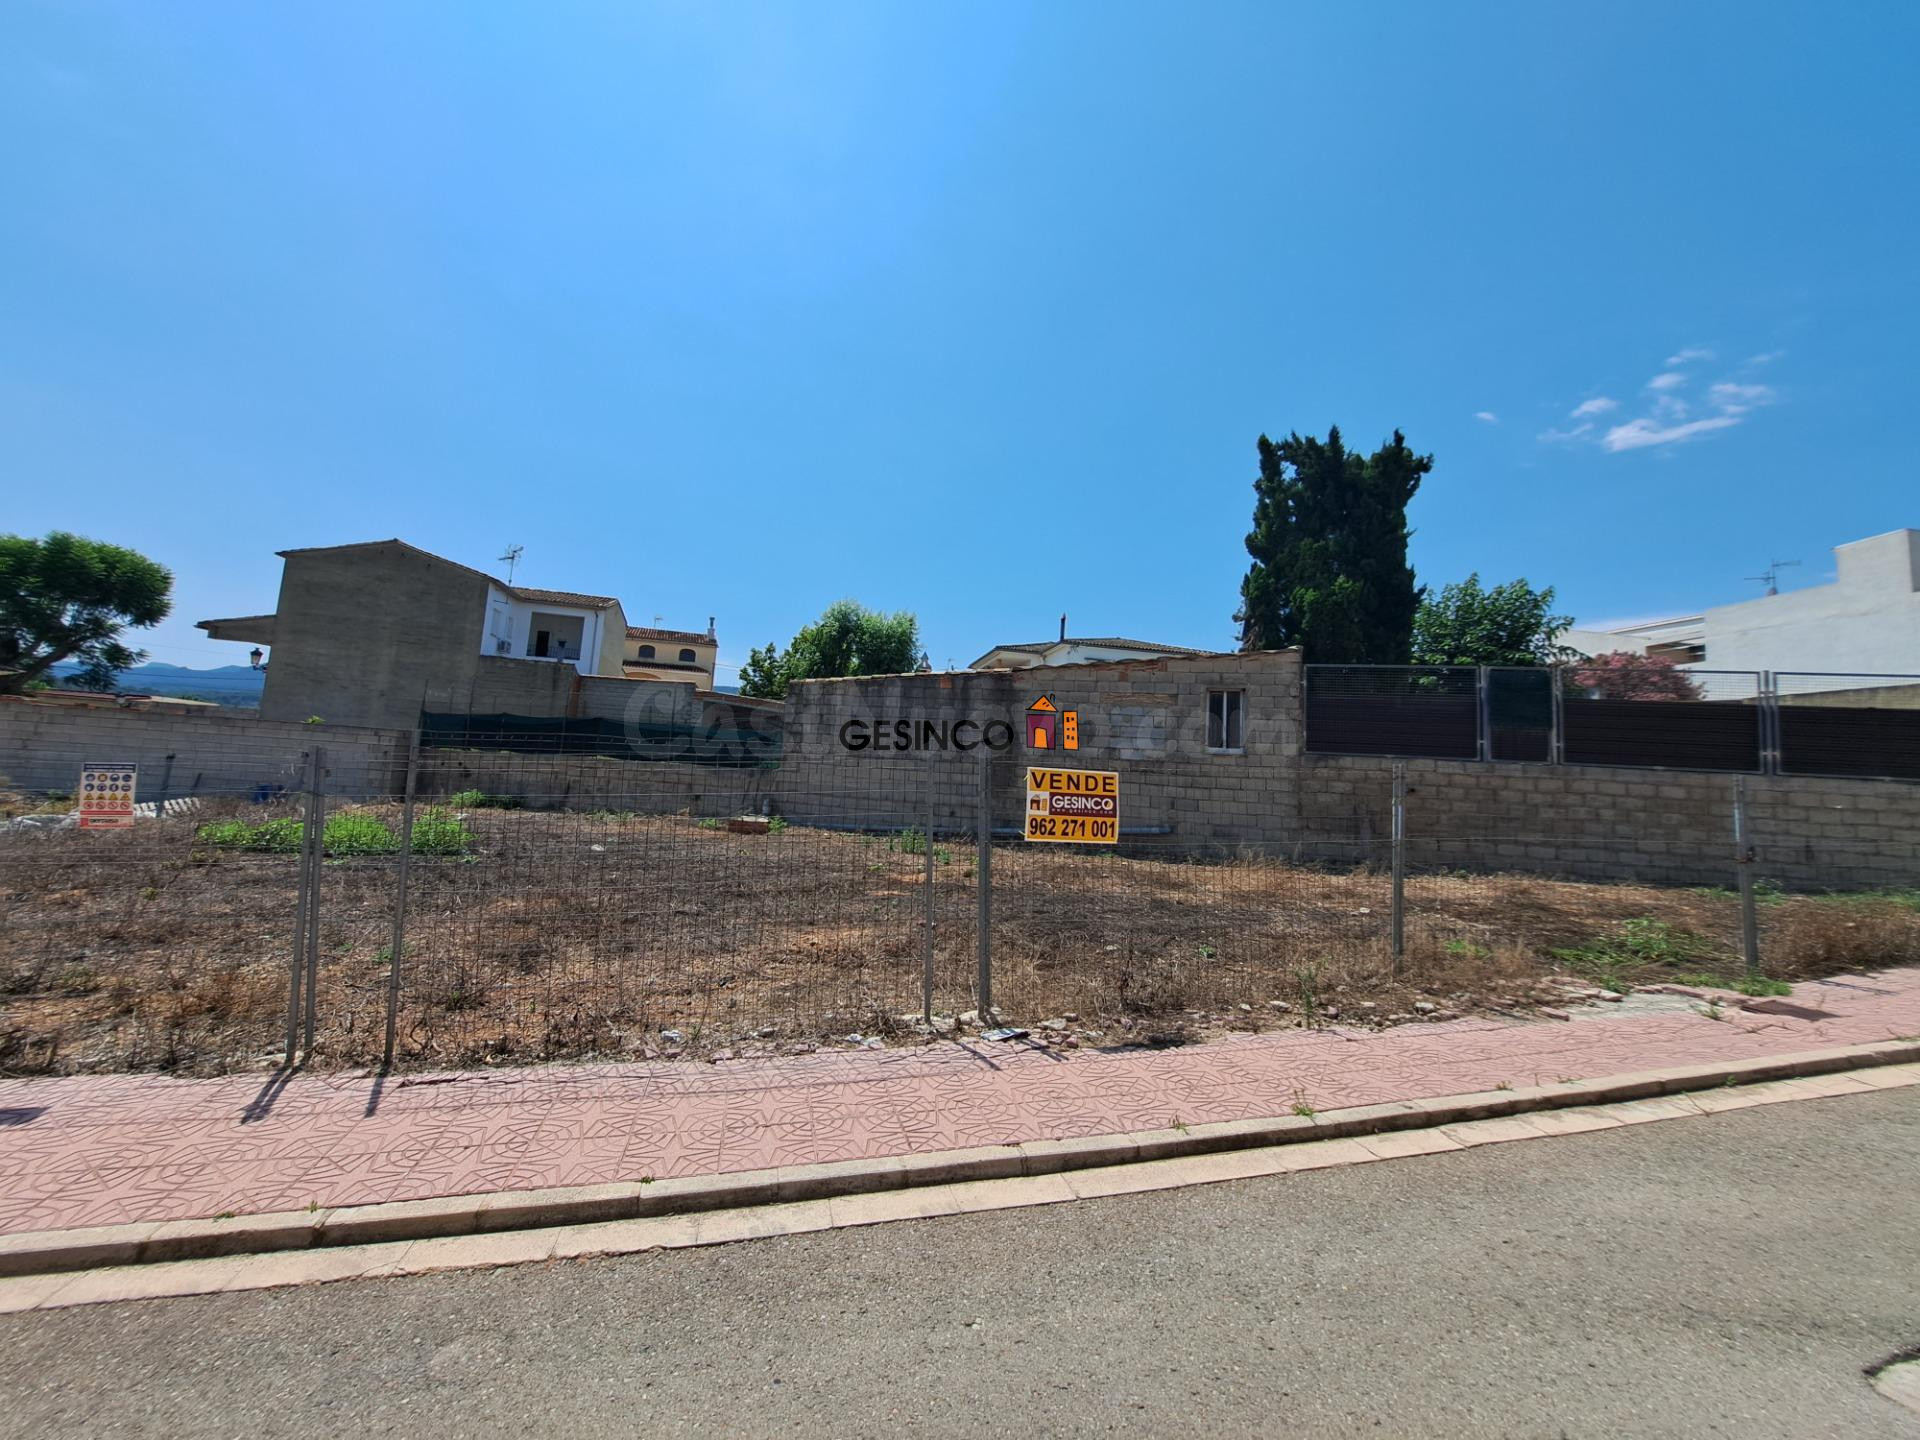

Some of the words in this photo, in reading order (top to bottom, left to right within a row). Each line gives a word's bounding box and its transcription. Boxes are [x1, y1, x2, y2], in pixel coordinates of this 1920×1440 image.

[1031, 772, 1115, 793] VENDE
[1052, 795, 1114, 811] GESINCO
[1029, 817, 1056, 836] 962
[1061, 819, 1086, 837] 271
[1091, 820, 1115, 838] 001
